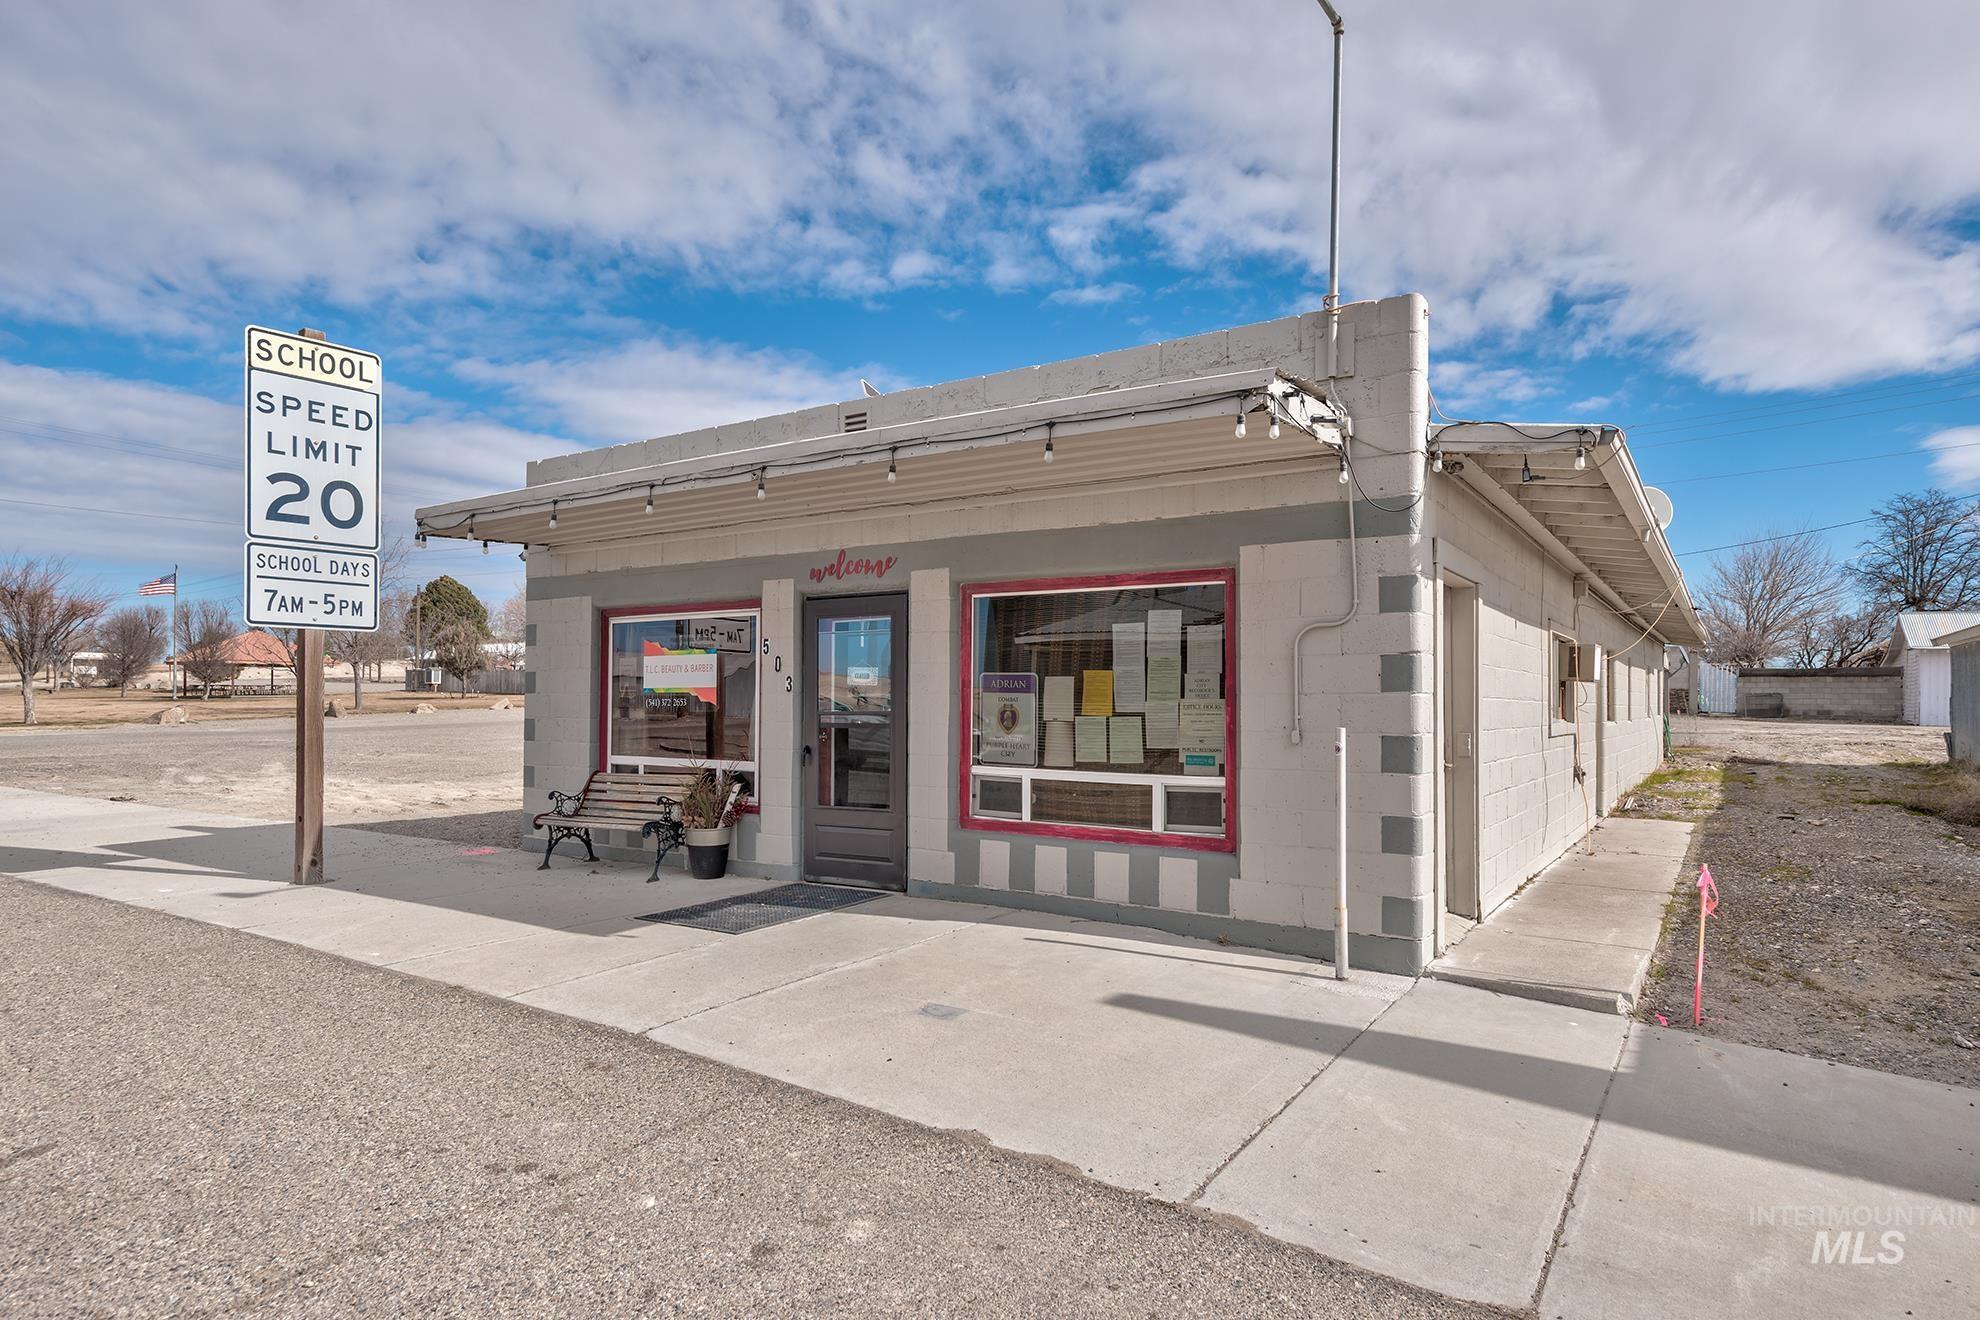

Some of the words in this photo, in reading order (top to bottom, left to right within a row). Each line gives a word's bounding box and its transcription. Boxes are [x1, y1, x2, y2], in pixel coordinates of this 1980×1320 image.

[256, 338, 373, 384] SCHOOL
[256, 391, 373, 431] SPEED
[267, 431, 362, 467] LIMIT
[265, 472, 364, 529] 20
[256, 553, 322, 574] SCHOOL
[329, 559, 370, 578] DAYS
[809, 549, 898, 583] welcome
[661, 664, 684, 674] BEAUTY
[684, 664, 689, 673] &
[690, 663, 714, 673] BARBER
[991, 679, 1026, 688] ADRIAN
